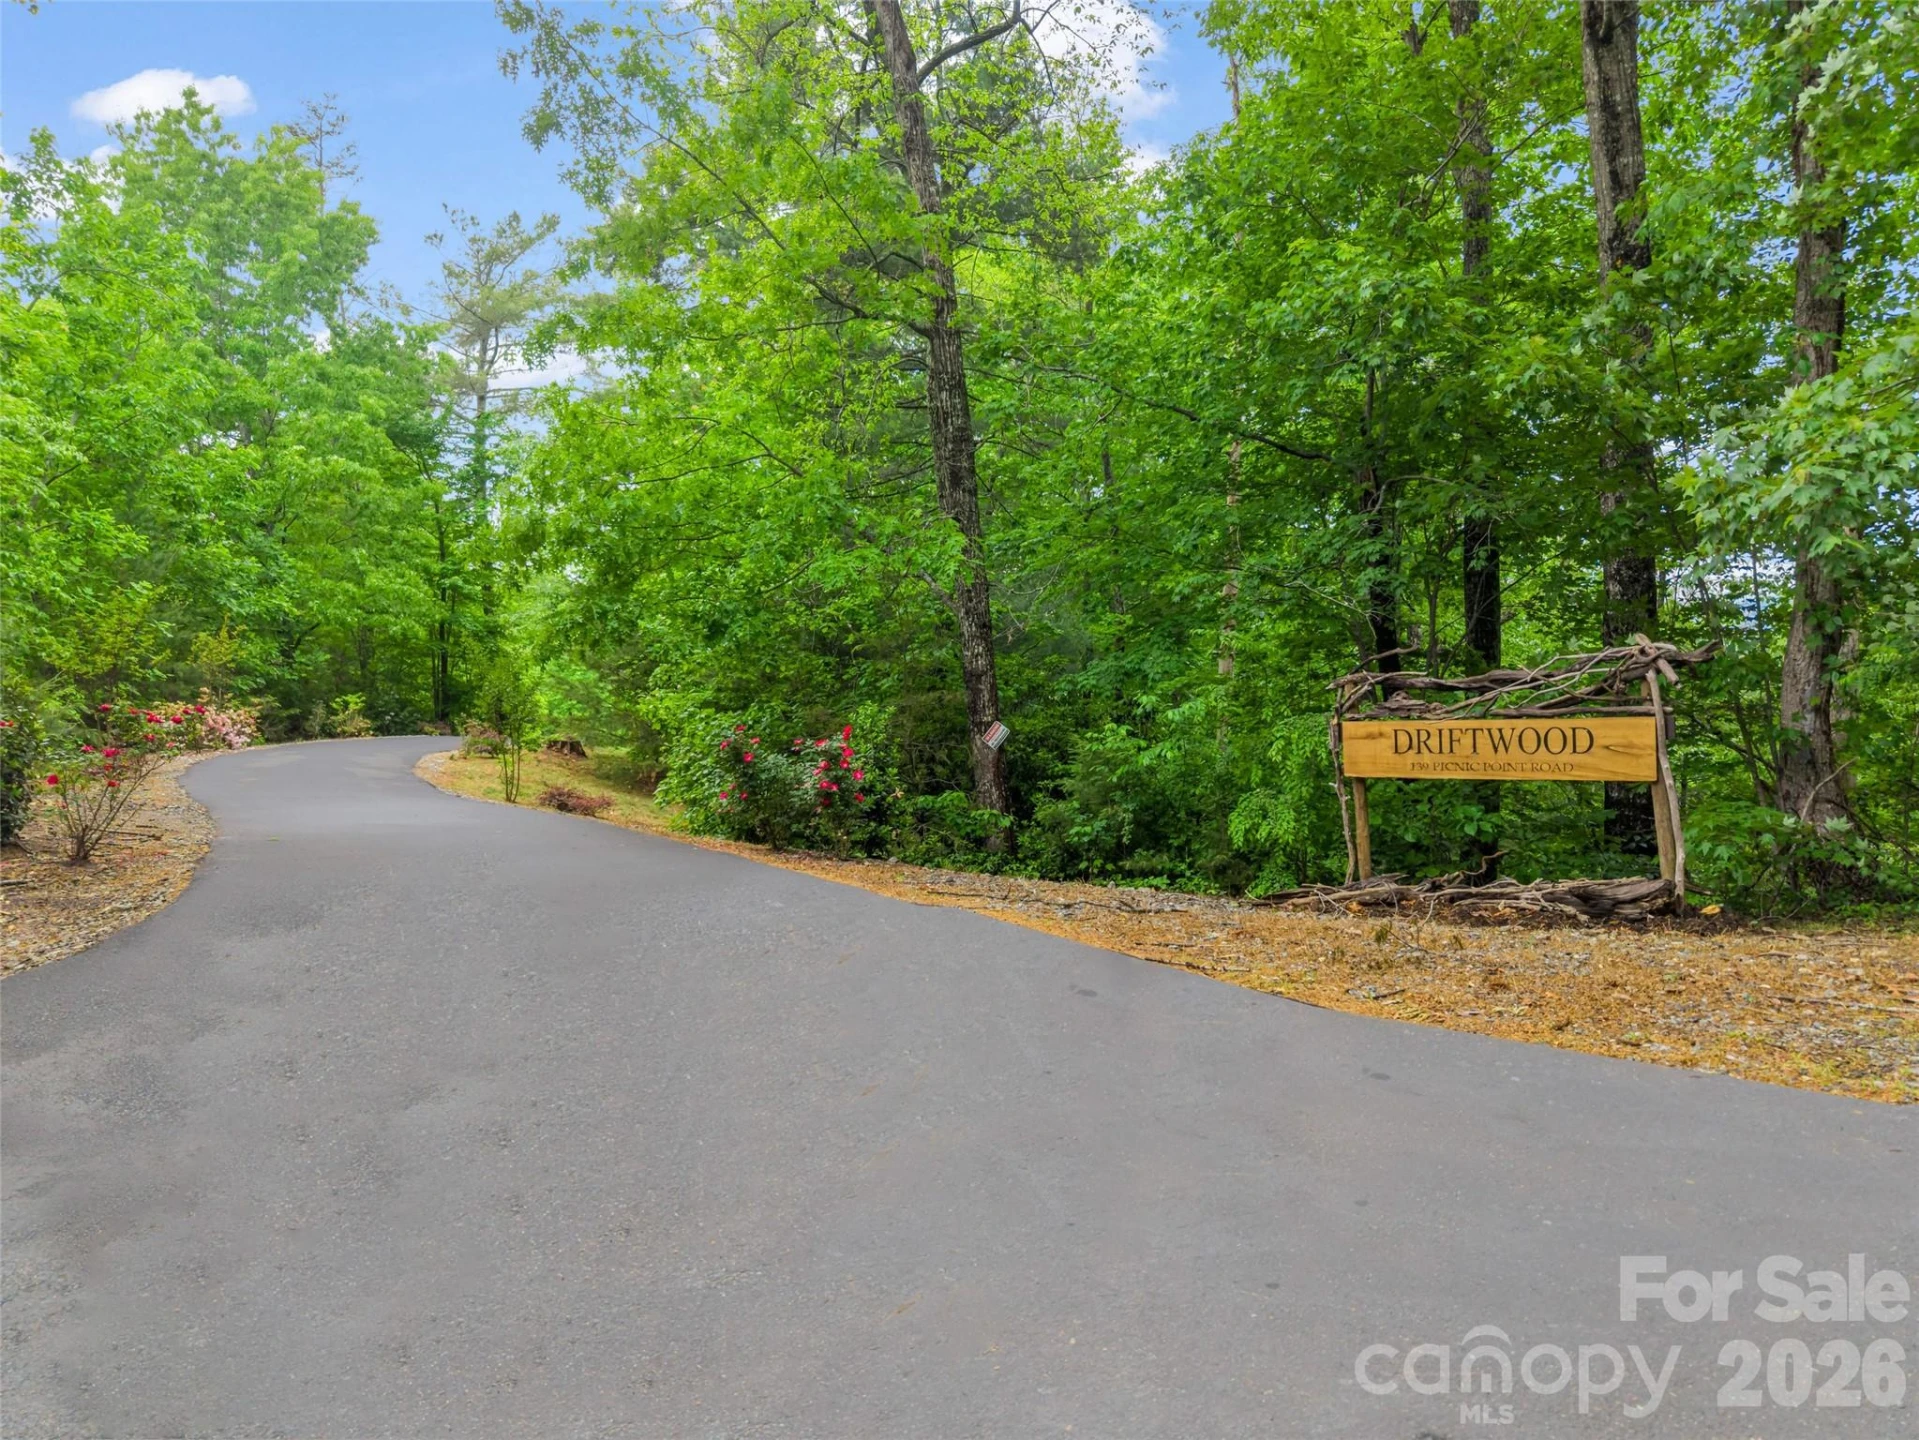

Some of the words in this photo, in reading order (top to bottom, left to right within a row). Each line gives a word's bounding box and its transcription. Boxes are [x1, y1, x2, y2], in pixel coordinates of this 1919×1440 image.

[1392, 726, 1595, 756] DRIFTWOOD
[1432, 761, 1481, 773] PICNIC
[1483, 761, 1527, 773] POINT
[1530, 761, 1574, 773] ROAD
